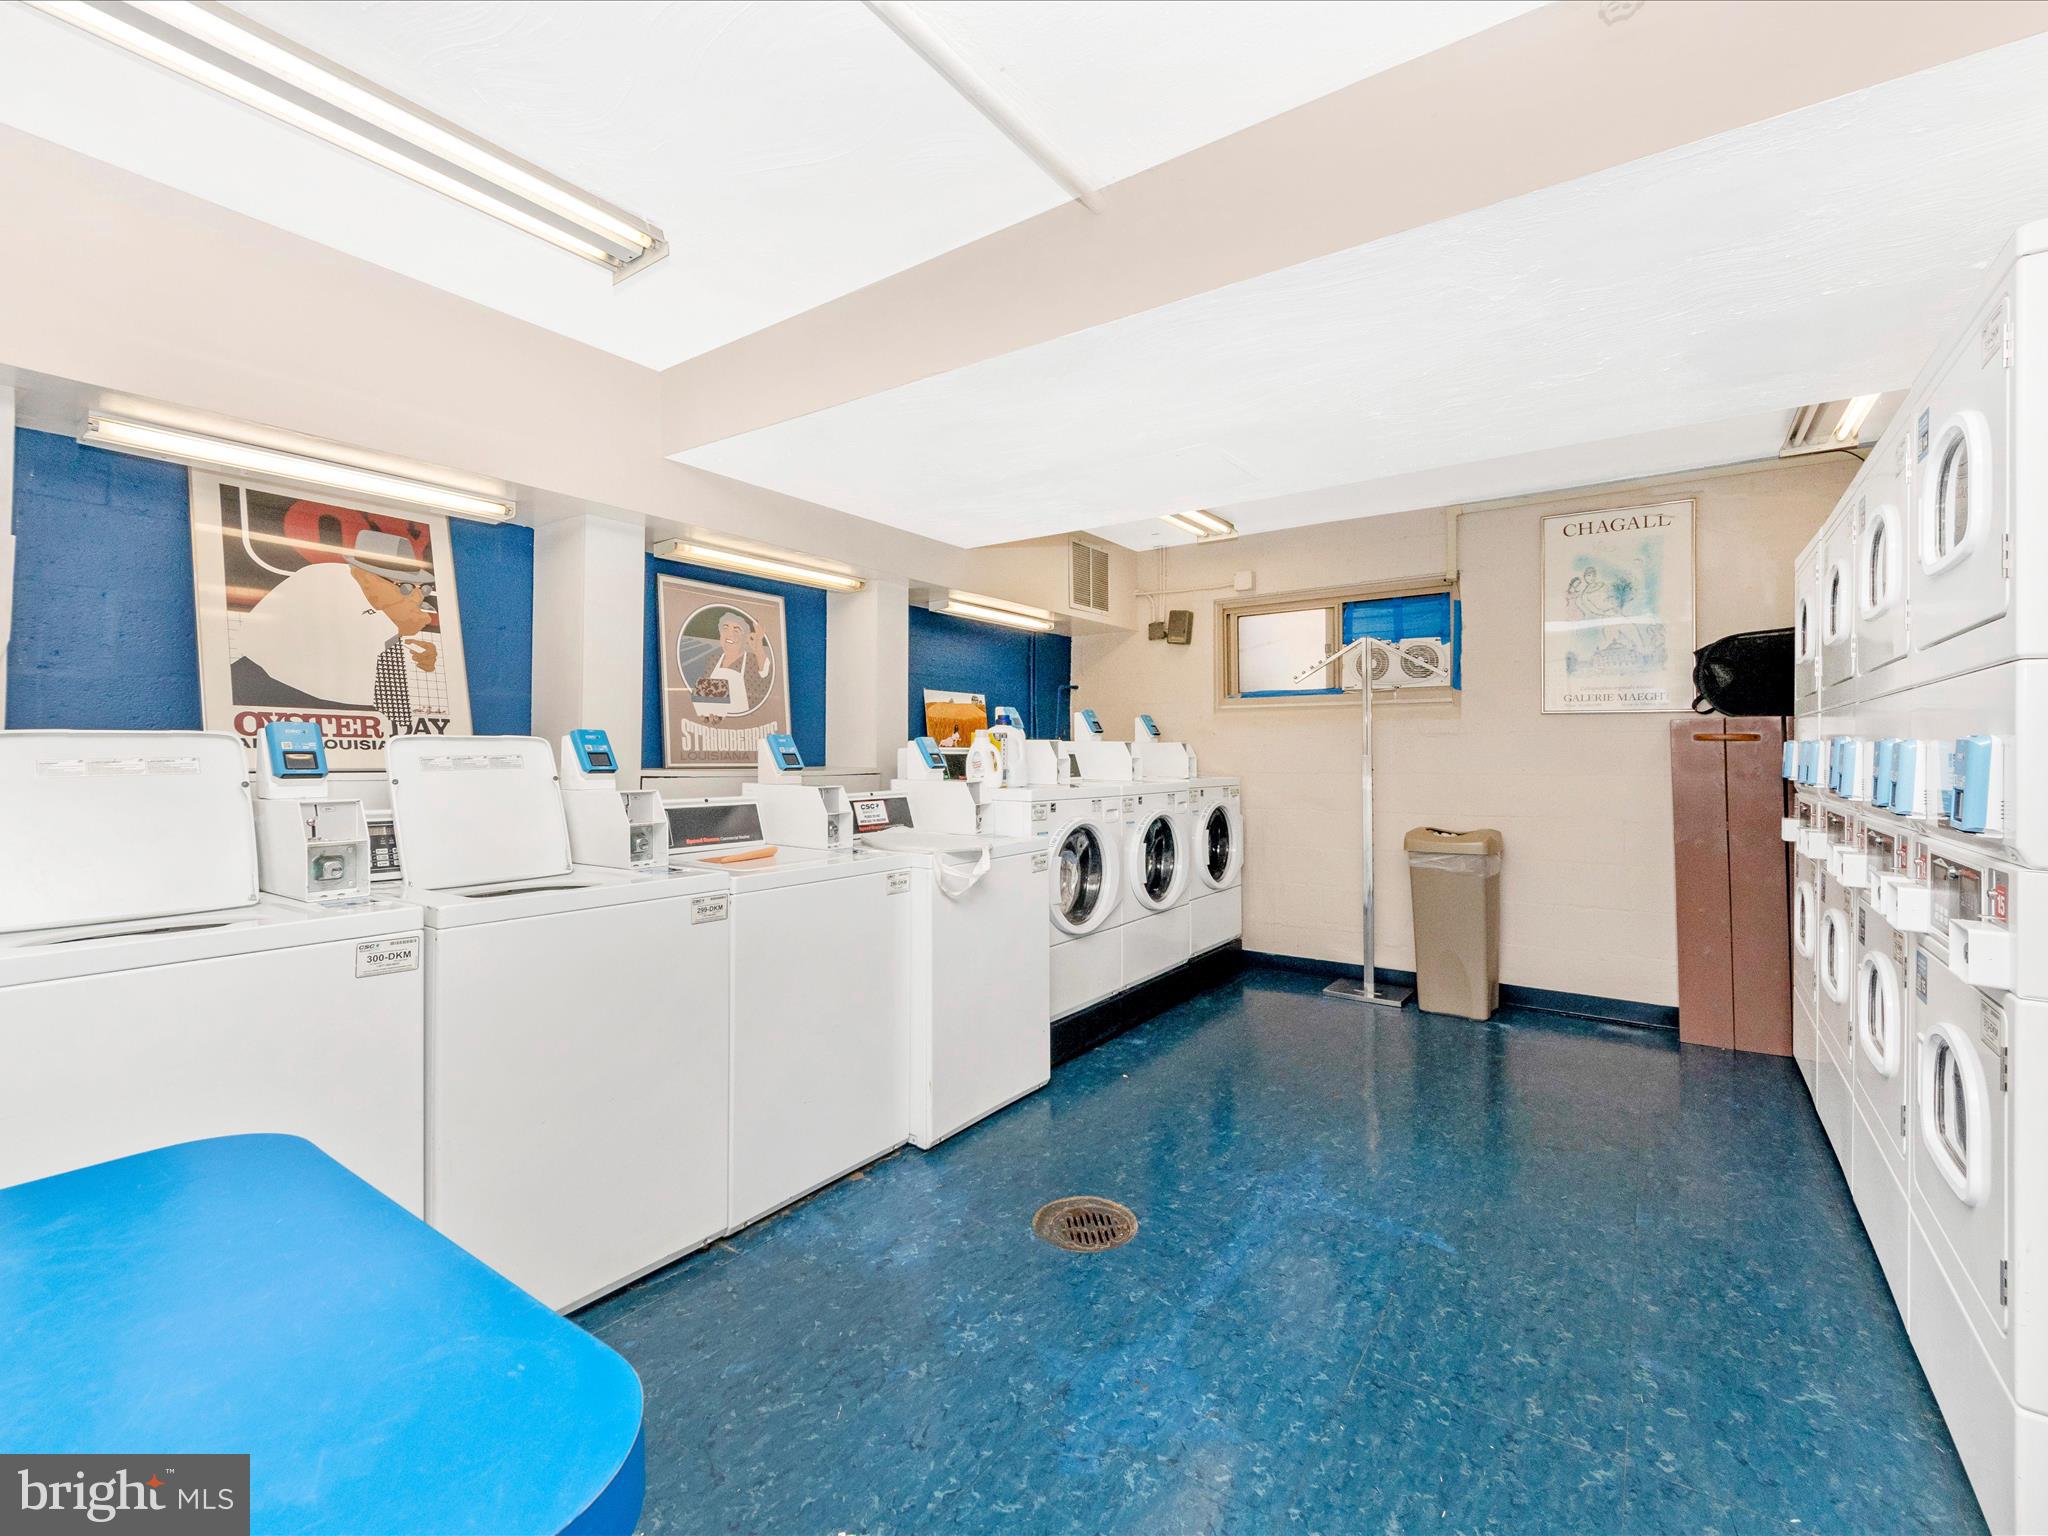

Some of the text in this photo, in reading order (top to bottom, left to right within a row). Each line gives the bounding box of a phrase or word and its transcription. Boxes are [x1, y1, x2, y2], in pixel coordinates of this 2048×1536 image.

[1562, 513, 1671, 538] CHAGALL
[1563, 693, 1614, 703] GALERIE
[681, 751, 751, 761] LOUISIANA
[366, 950, 412, 964] 300-DKM
